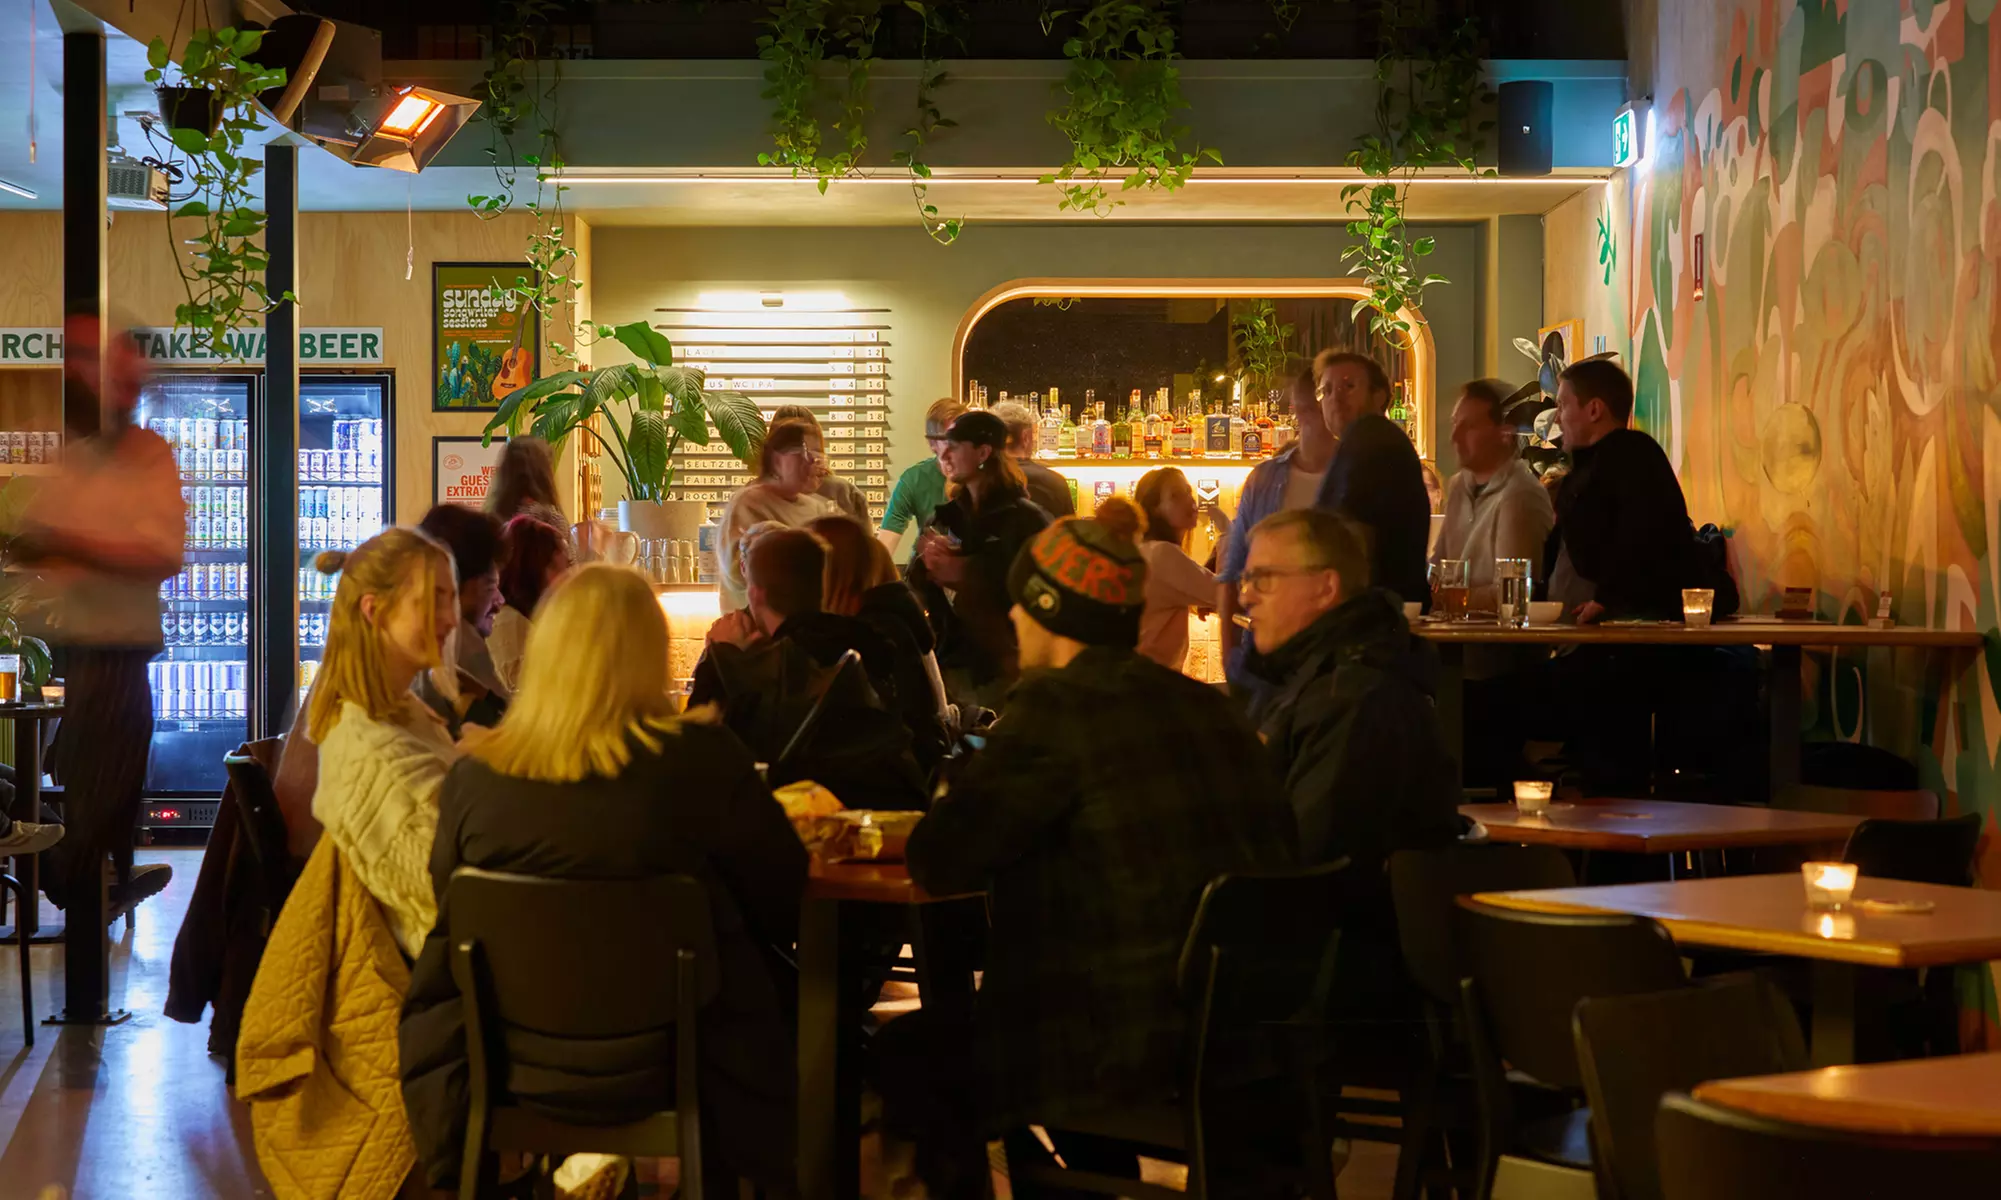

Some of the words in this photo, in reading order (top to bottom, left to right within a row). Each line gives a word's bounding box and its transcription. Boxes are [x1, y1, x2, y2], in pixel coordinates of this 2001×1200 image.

[443, 285, 516, 312] sunday
[443, 306, 499, 318] songwriter
[443, 317, 487, 328] sessions
[2, 333, 64, 358] RCH
[133, 333, 266, 358] TAKEWA
[299, 333, 378, 358] BEER
[461, 475, 491, 485] GUES
[446, 486, 488, 496] EXTRAV
